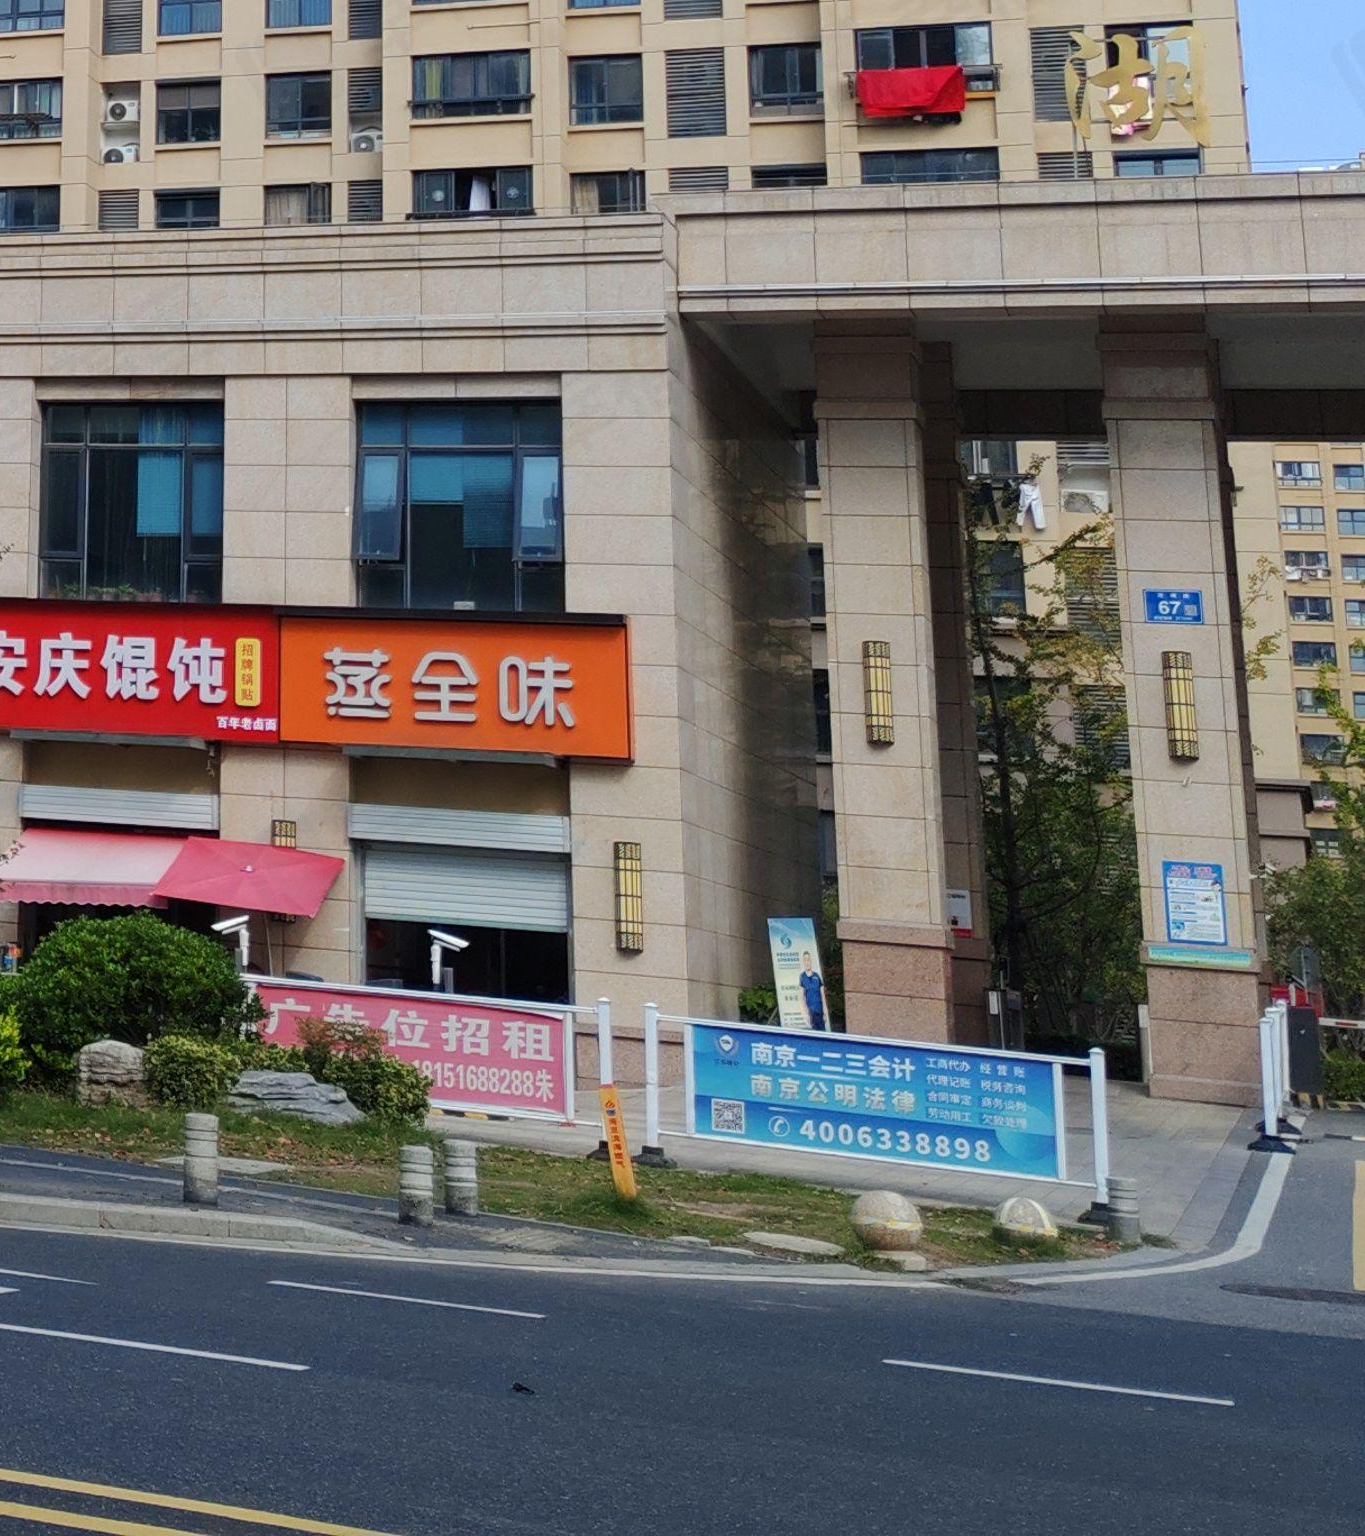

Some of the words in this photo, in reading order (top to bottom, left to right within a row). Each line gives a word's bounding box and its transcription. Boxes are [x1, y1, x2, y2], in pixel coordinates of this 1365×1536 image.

[1158, 600, 1181, 615] 67
[323, 646, 576, 728] 蒸全味
[751, 1042, 916, 1082] 南京一二三会计
[751, 1074, 916, 1113] 南京公明法律
[799, 1119, 991, 1162] 4006338898
